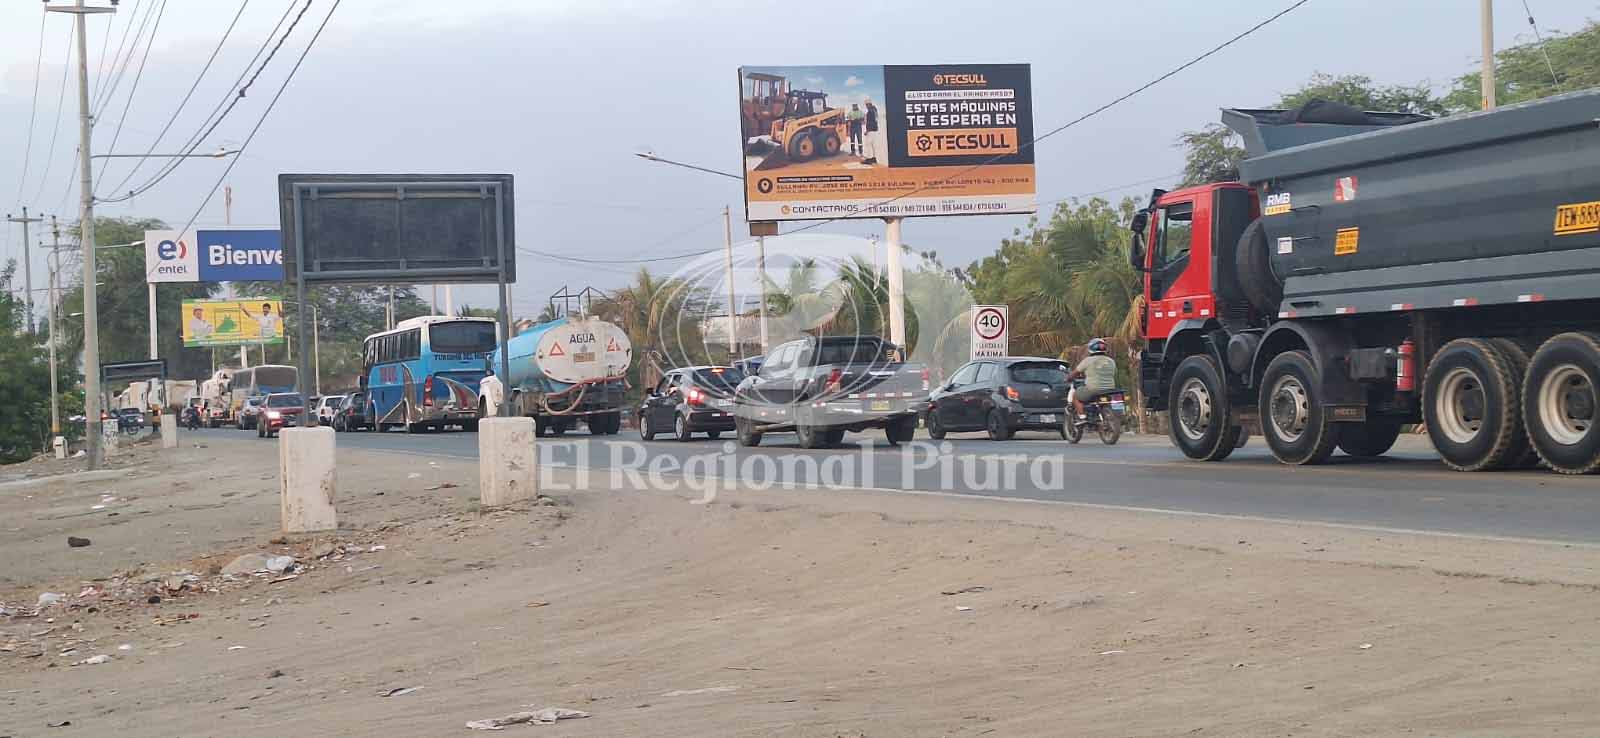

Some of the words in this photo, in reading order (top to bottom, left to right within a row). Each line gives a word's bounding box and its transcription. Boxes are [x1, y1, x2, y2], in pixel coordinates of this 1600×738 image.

[943, 74, 987, 84] TECSULL
[905, 103, 947, 113] ESTAS
[950, 100, 1016, 113] MÁQUINAS
[906, 115, 926, 126] TE
[930, 113, 992, 126] ESPERA
[995, 113, 1017, 125] EN
[933, 133, 1011, 151] TECSULL
[1267, 192, 1290, 206] RMB
[158, 264, 187, 274] entel
[978, 314, 1000, 328] 40
[569, 333, 596, 345] AGUA
